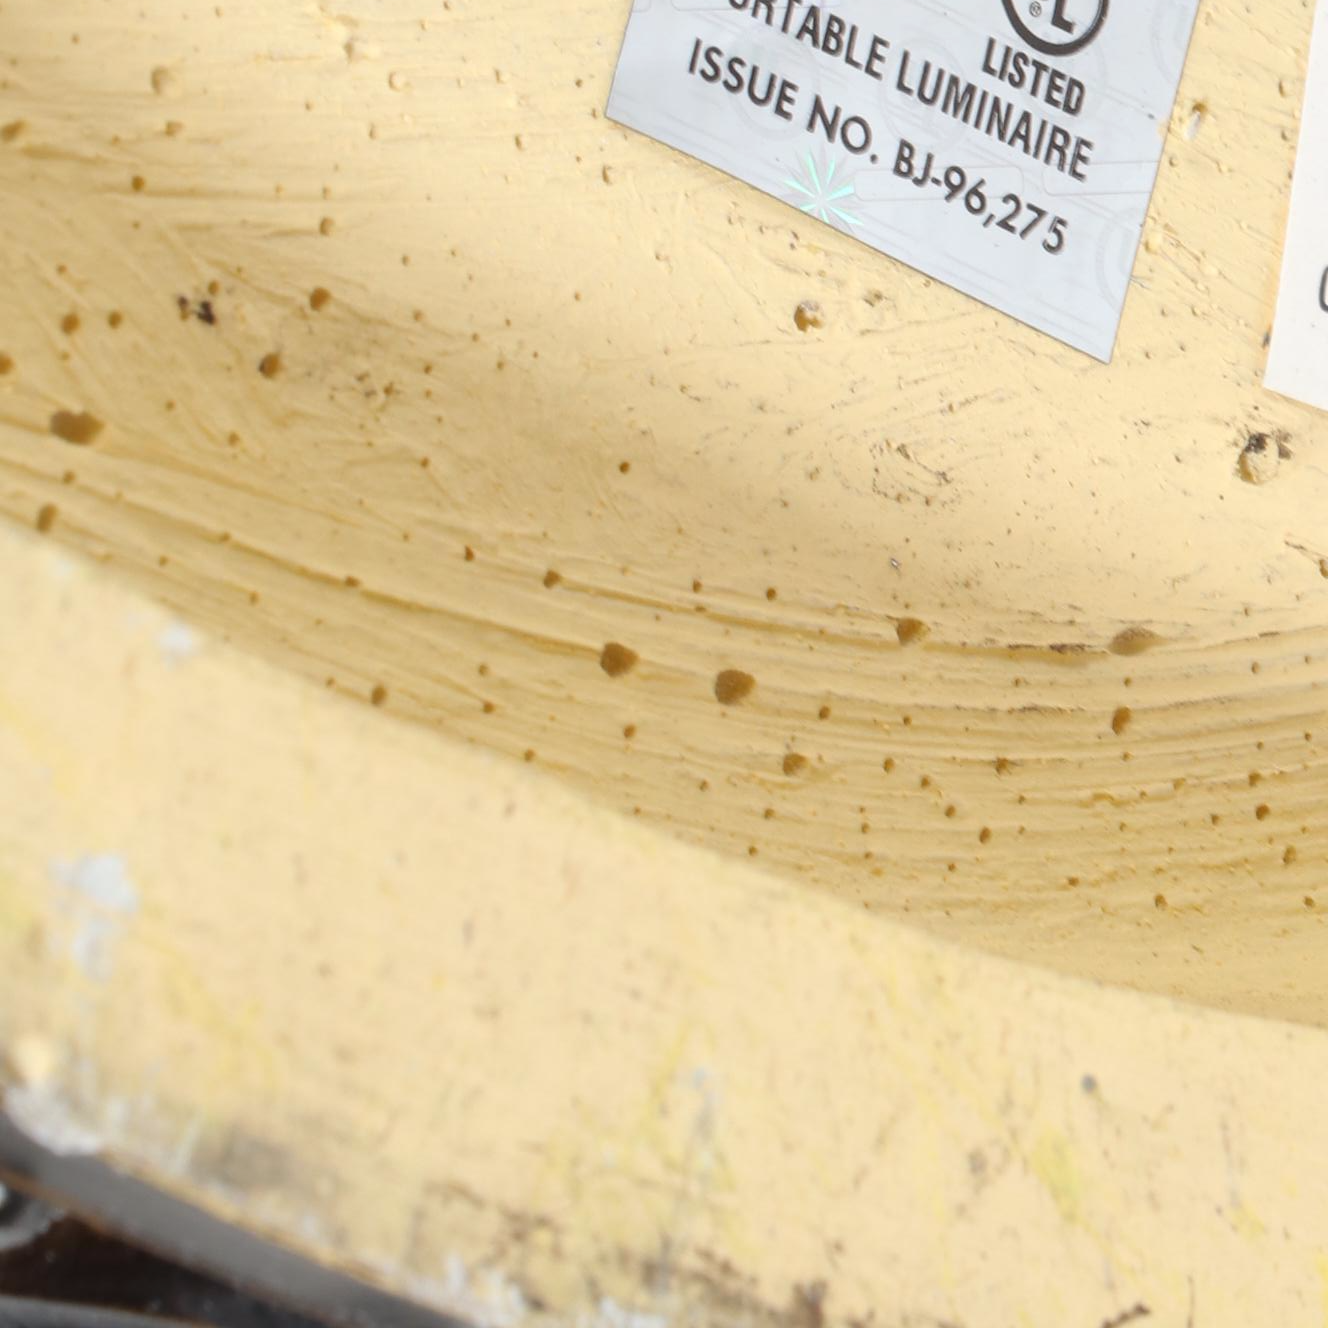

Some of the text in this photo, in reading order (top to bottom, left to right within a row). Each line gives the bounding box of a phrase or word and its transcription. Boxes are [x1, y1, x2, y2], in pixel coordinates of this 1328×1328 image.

[895, 49, 1094, 182] LUMINAIRE
[981, 36, 1086, 117] LISTED
[687, 37, 1069, 255] ISSUE NO. BJ-96,275
